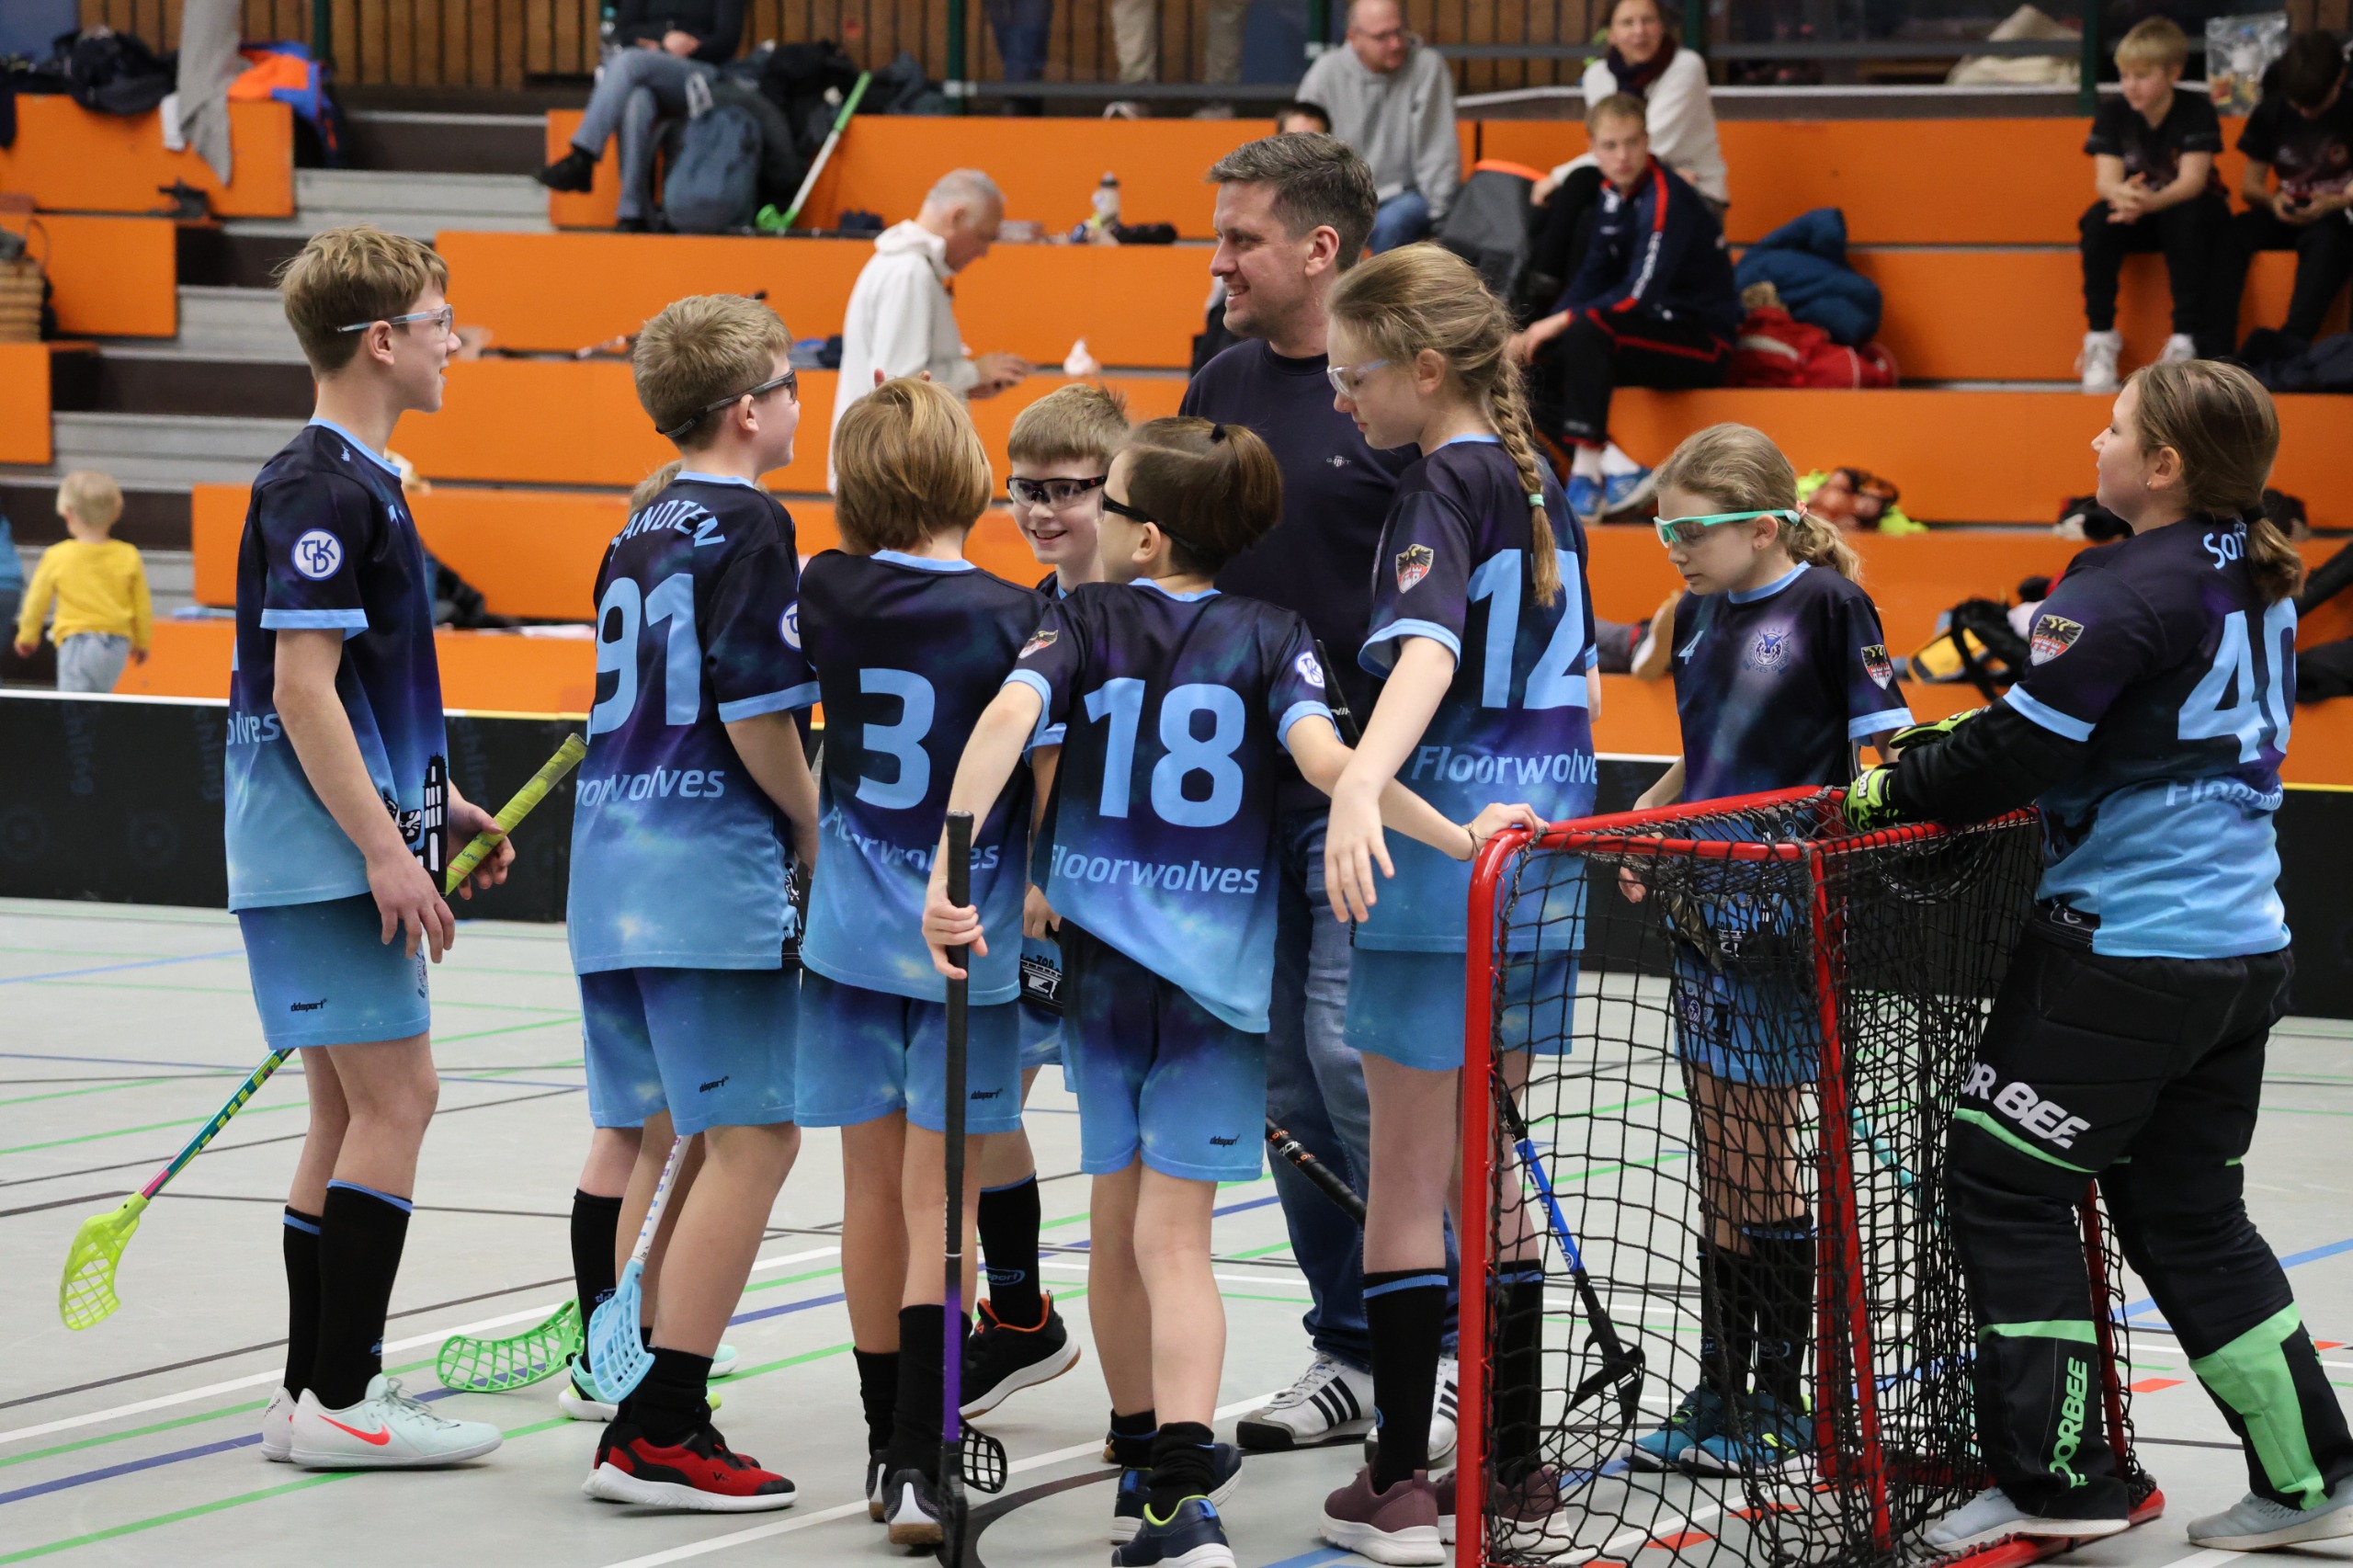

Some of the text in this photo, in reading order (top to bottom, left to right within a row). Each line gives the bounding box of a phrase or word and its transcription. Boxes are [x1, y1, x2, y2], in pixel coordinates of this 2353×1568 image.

[586, 574, 701, 744] 91
[1467, 549, 1588, 710] 12
[1678, 631, 1703, 665] 4
[2178, 597, 2297, 764] 40
[856, 668, 935, 809] 3
[1084, 677, 1245, 827] 18
